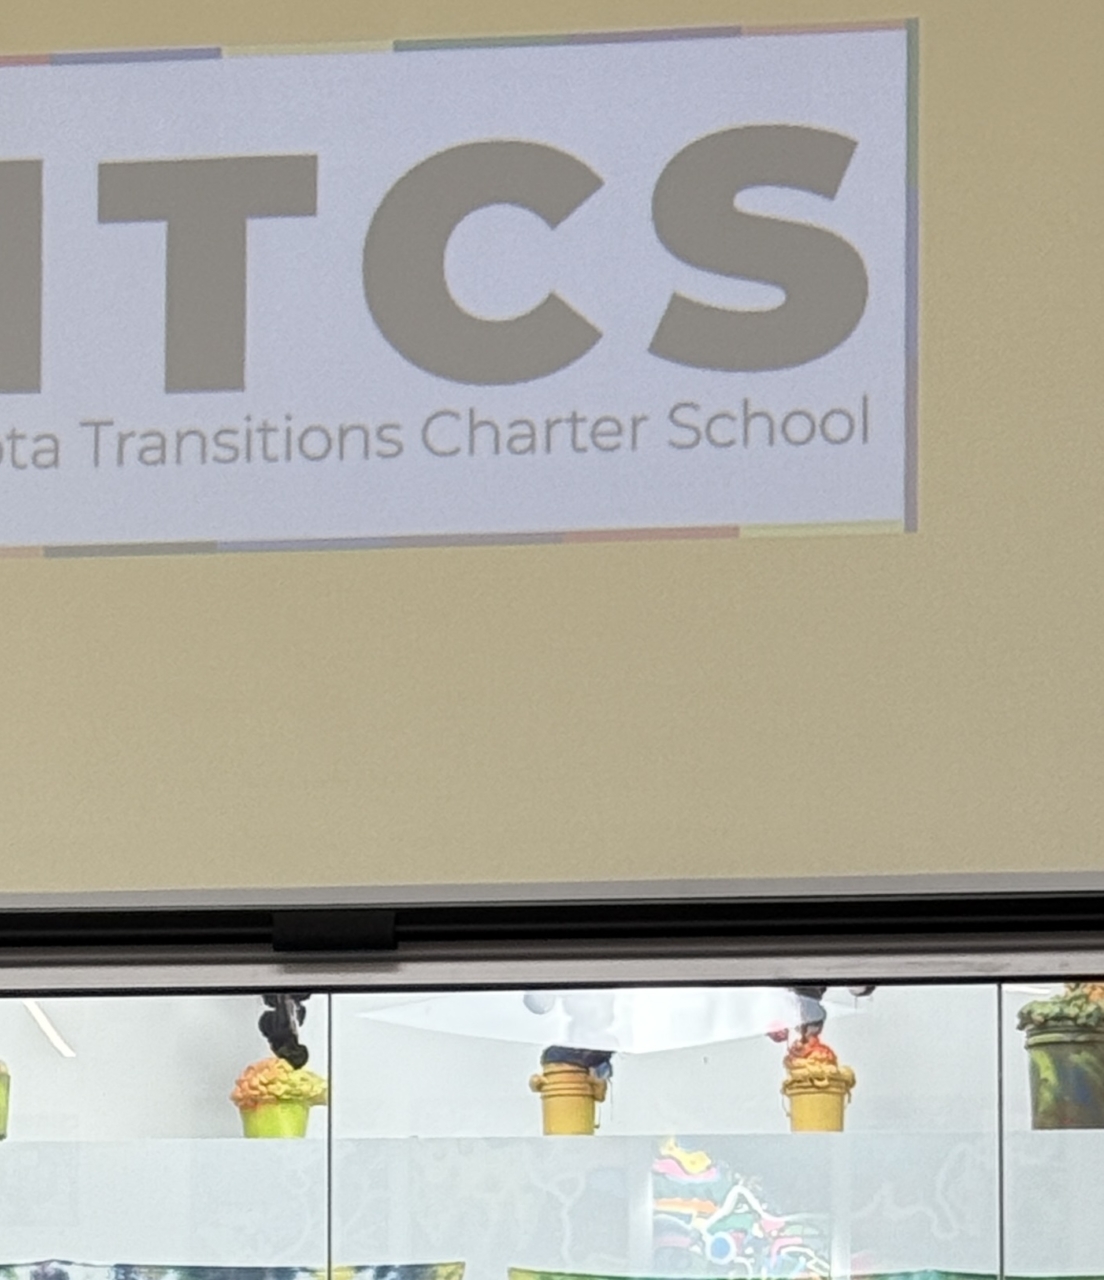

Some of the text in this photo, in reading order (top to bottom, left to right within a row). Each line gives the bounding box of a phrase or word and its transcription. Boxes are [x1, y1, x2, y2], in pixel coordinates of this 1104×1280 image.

[79, 414, 404, 470] Transitions
[420, 406, 650, 459] Charter
[667, 395, 871, 452] School
